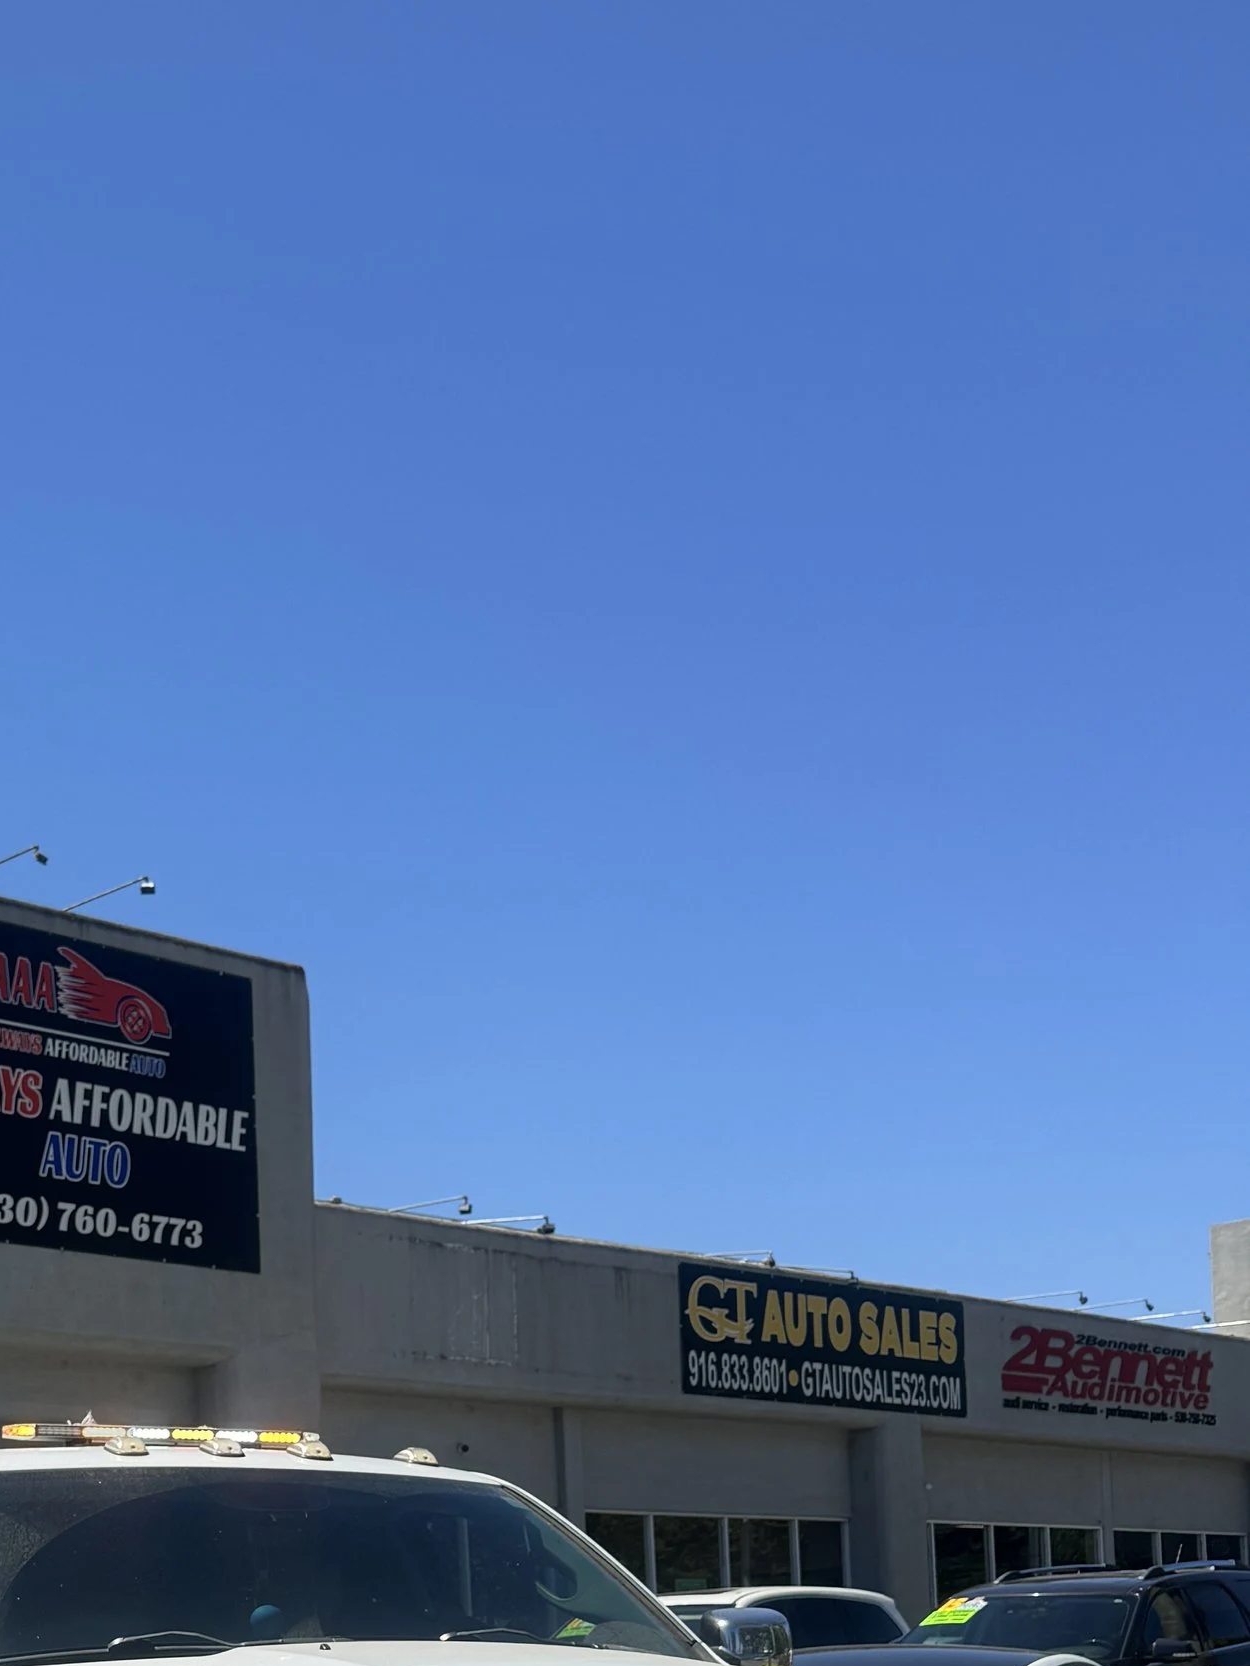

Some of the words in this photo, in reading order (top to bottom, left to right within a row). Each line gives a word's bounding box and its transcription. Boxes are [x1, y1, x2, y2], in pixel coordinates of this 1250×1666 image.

[44, 1038, 130, 1071] AFFORDABLE
[129, 1054, 166, 1078] AUTO
[49, 1078, 249, 1152] AFFORDABLE
[39, 1131, 131, 1188] AUTO
[56, 1201, 203, 1249] 760-6773
[685, 1275, 757, 1344] GT
[761, 1289, 851, 1352] AUTO
[859, 1301, 958, 1364] SALES
[1074, 1333, 1186, 1357] 2Bennett.com
[688, 1349, 787, 1394] 916.833.8601
[801, 1361, 961, 1410] GTAUTOSALES23.COM
[1002, 1325, 1214, 1392] 2Bennett
[1046, 1375, 1210, 1410] Audimotive
